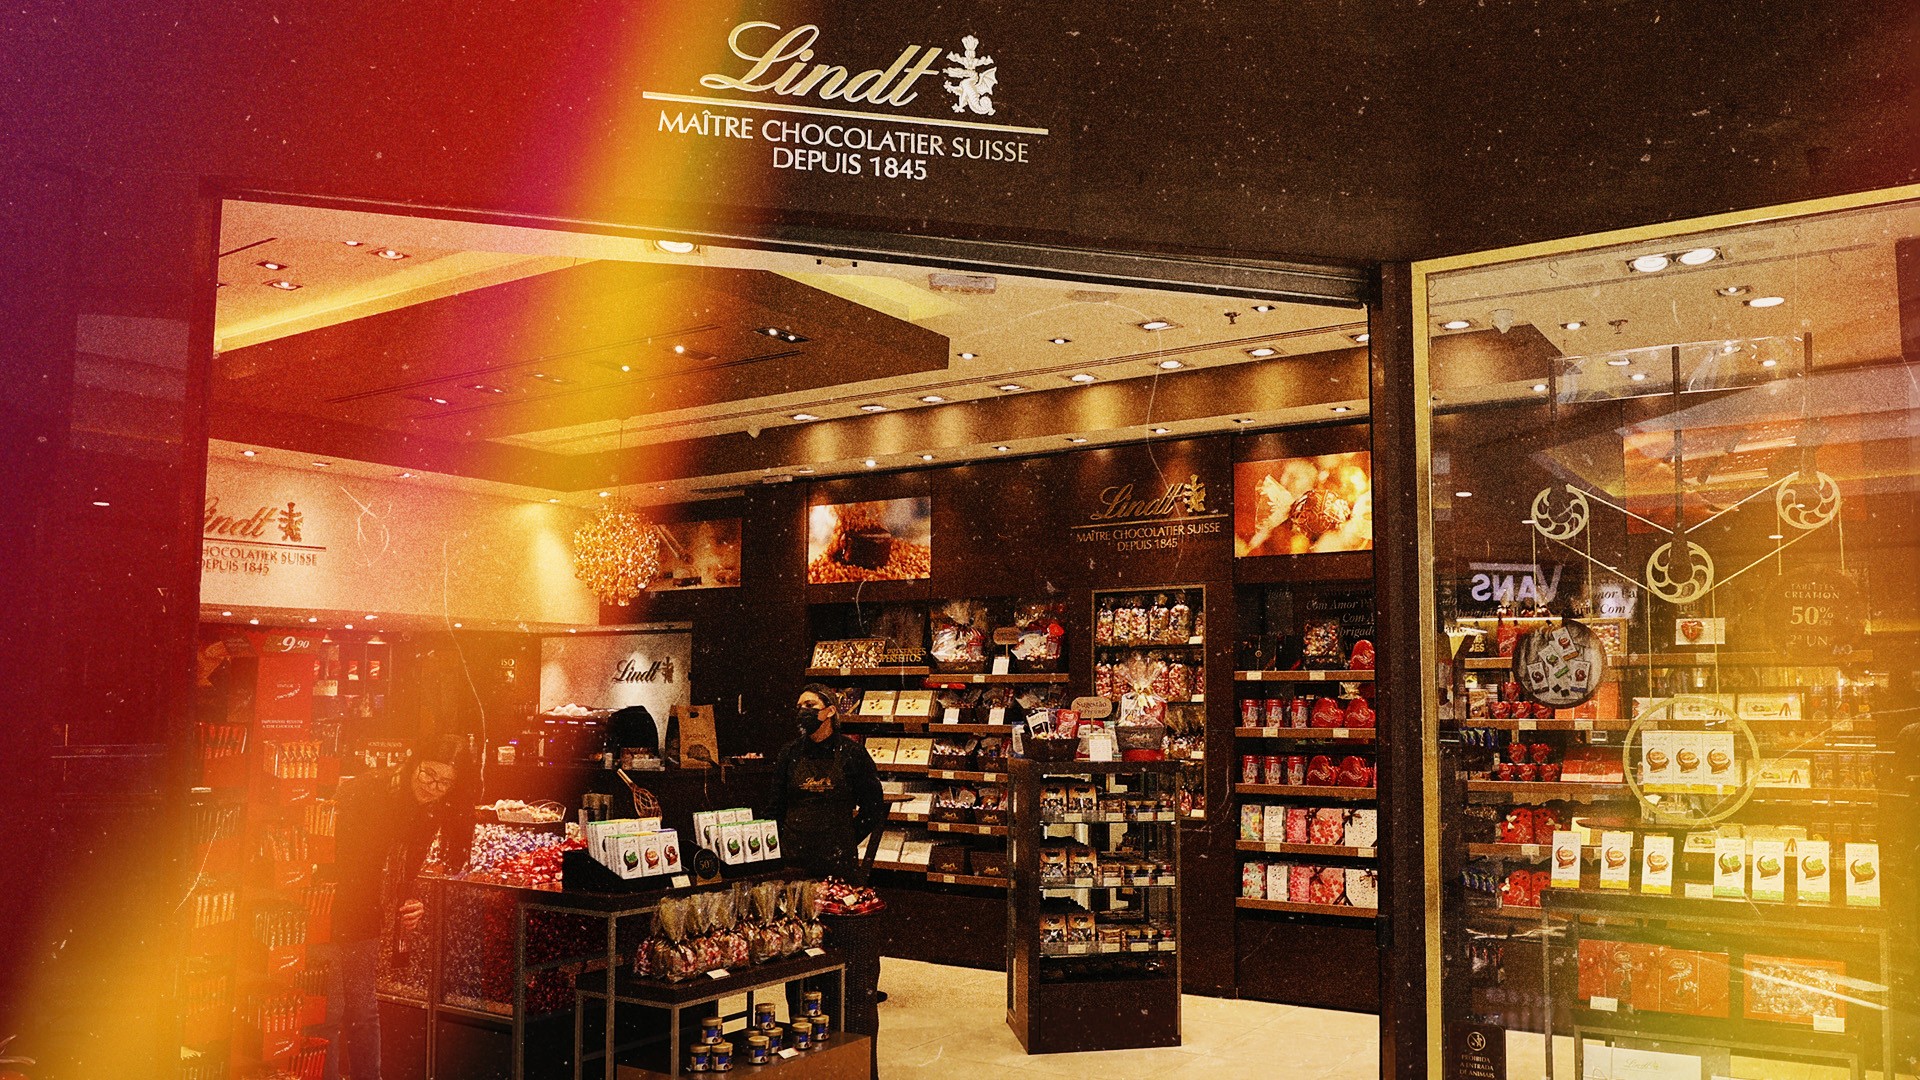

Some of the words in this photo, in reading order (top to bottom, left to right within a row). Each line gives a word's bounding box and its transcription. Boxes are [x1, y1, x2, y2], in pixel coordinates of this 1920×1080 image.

[700, 21, 942, 107] Lindt
[658, 110, 753, 139] MAÎTRE
[762, 120, 944, 157] CHOCOLATIER
[951, 140, 1029, 164] SUISSE
[773, 147, 861, 175] DEPUIS
[870, 155, 927, 180] 1845
[1090, 483, 1185, 520] Lindt
[203, 497, 277, 538] indt
[1076, 530, 1110, 542] MAÎTRE
[1113, 525, 1184, 540] CHOCOLATIER
[1187, 522, 1221, 535] SUISSE
[203, 546, 277, 561] HOCOLATIER
[281, 552, 317, 566] SUISSE
[1117, 540, 1151, 551] DEPUIS
[1154, 538, 1178, 549] 1845
[244, 562, 270, 575] 1845
[612, 659, 661, 684] Lindt
